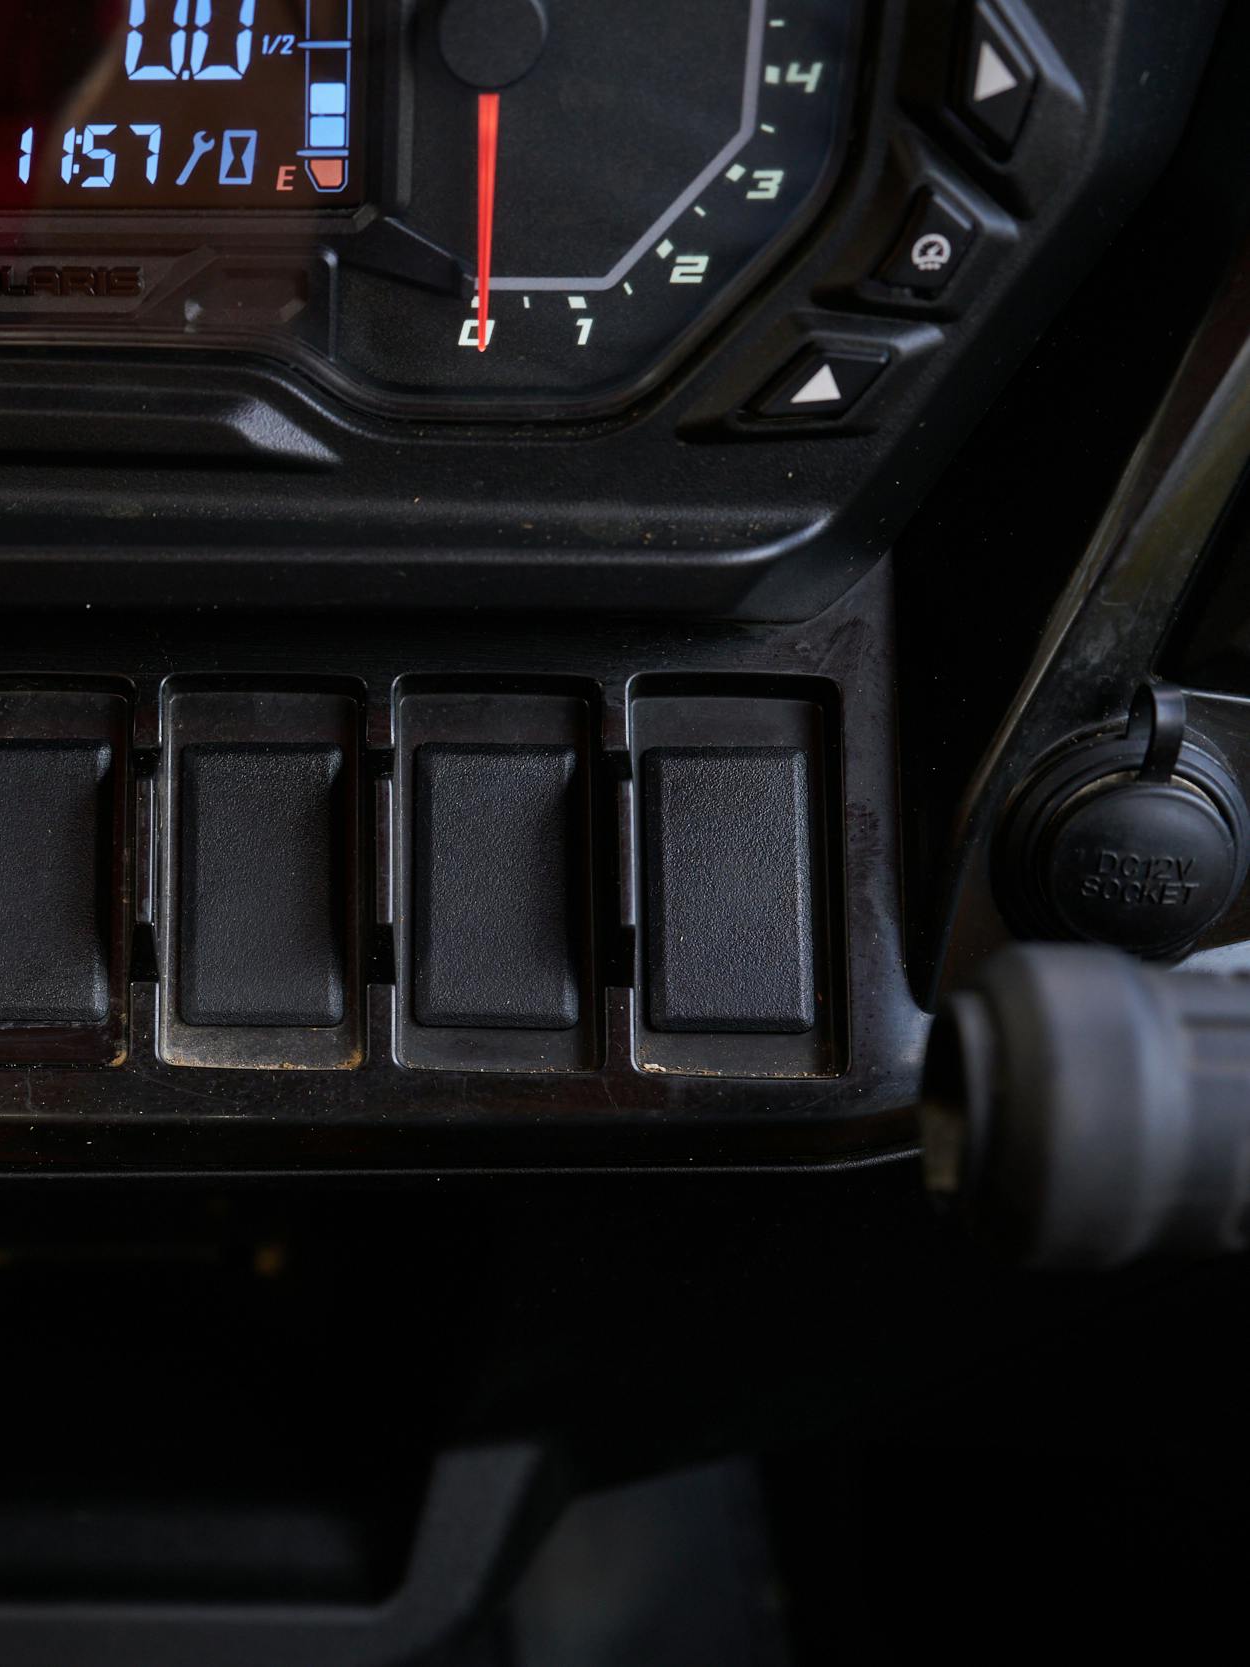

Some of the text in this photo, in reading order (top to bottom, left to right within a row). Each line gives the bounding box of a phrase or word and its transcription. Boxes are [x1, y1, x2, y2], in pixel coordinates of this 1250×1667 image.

[261, 33, 296, 56] 1/2
[784, 61, 823, 93] 4
[276, 164, 297, 191] E
[745, 169, 784, 200] 3
[669, 255, 710, 284] 2
[458, 319, 495, 347] 0
[575, 318, 593, 346] 1
[1097, 850, 1196, 881] DC12V
[1080, 876, 1200, 906] SOCKET
